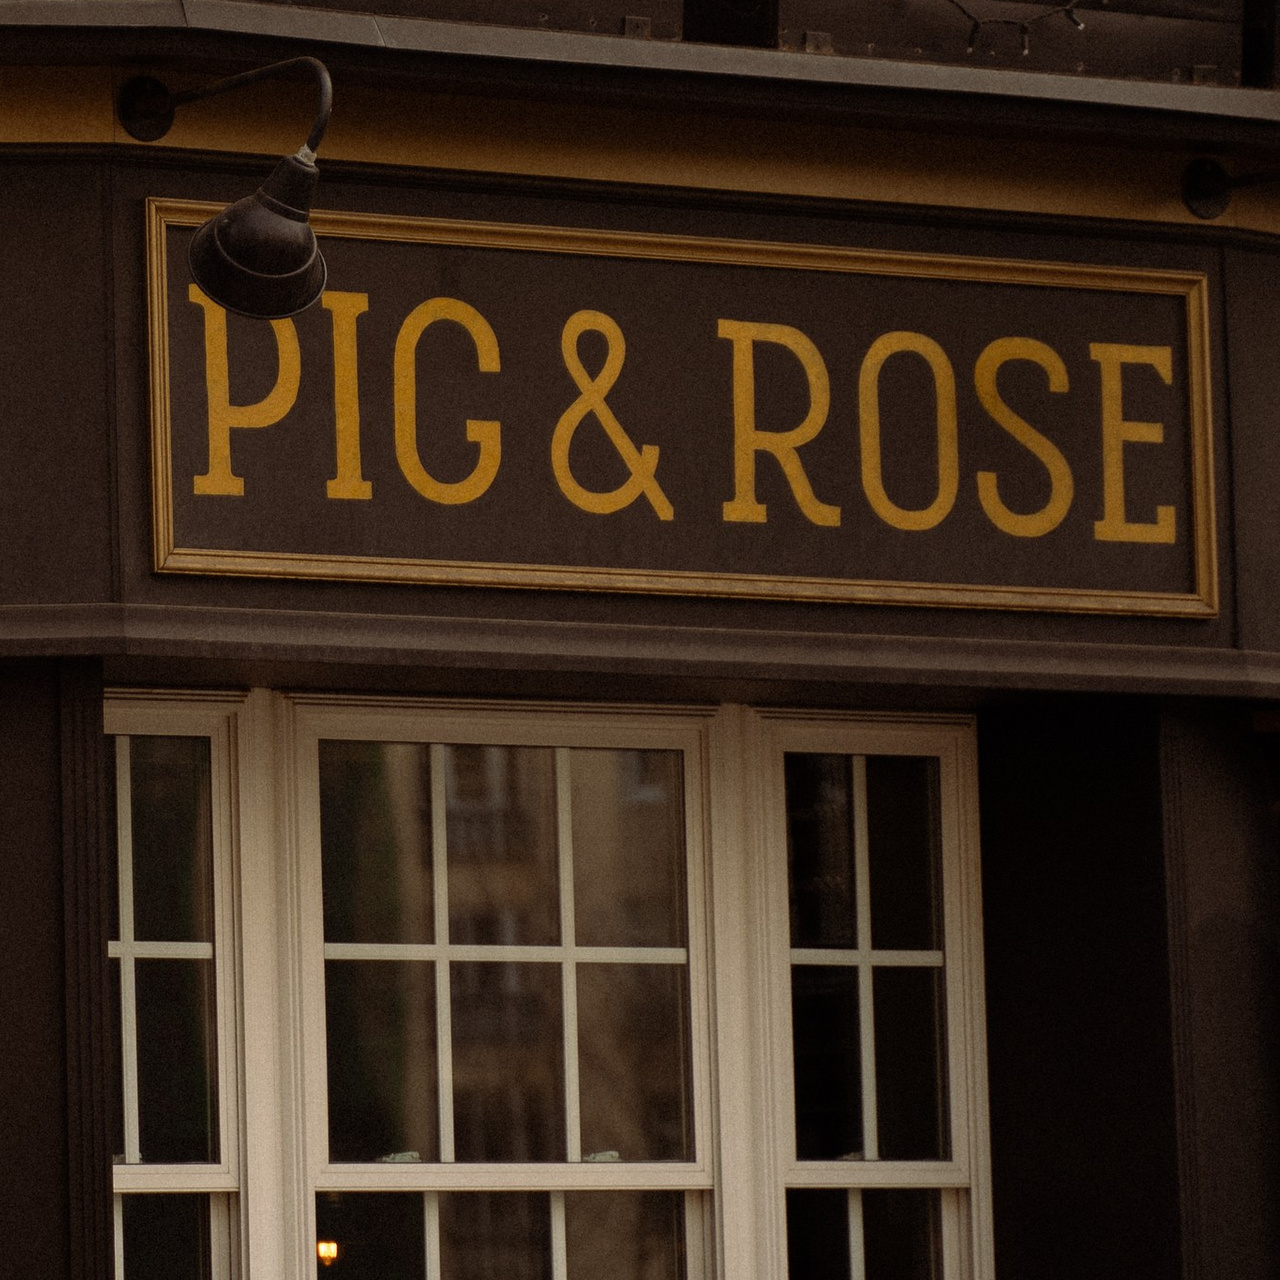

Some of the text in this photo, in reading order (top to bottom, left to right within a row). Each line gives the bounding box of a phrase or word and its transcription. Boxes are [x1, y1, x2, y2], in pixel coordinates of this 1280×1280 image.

[187, 282, 1177, 545] PIG & ROSE
